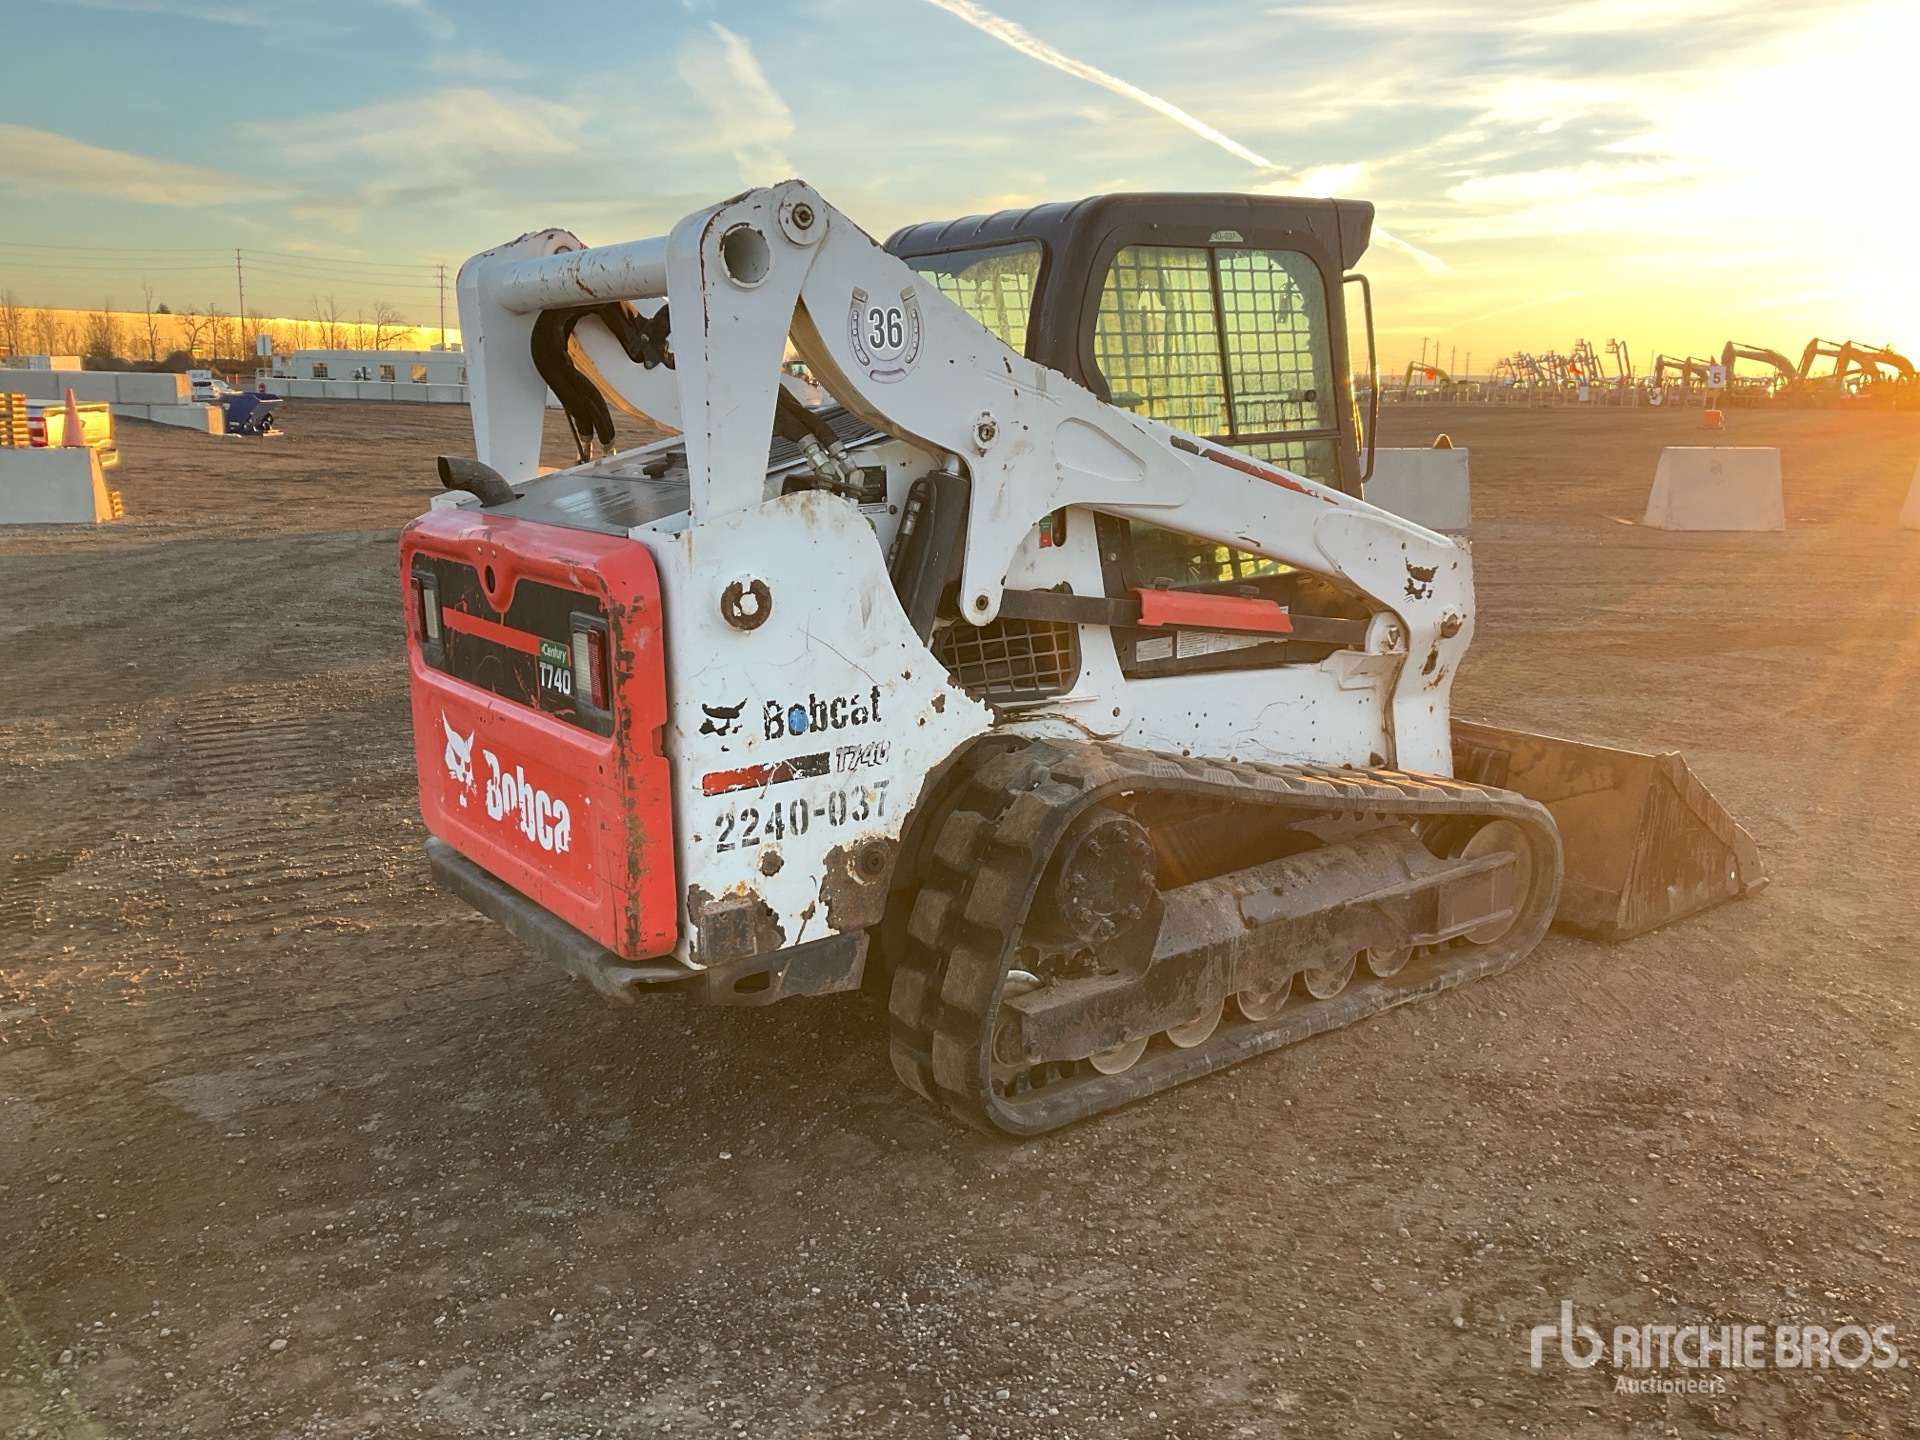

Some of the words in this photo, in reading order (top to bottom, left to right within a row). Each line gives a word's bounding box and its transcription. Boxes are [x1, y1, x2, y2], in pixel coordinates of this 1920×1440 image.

[868, 307, 903, 350] 36
[1712, 371, 1721, 384] 5
[541, 643, 567, 663] Century
[540, 661, 571, 695] T740
[763, 685, 882, 740] Bobcat
[836, 740, 891, 773] T740
[715, 780, 890, 854] 2240-037
